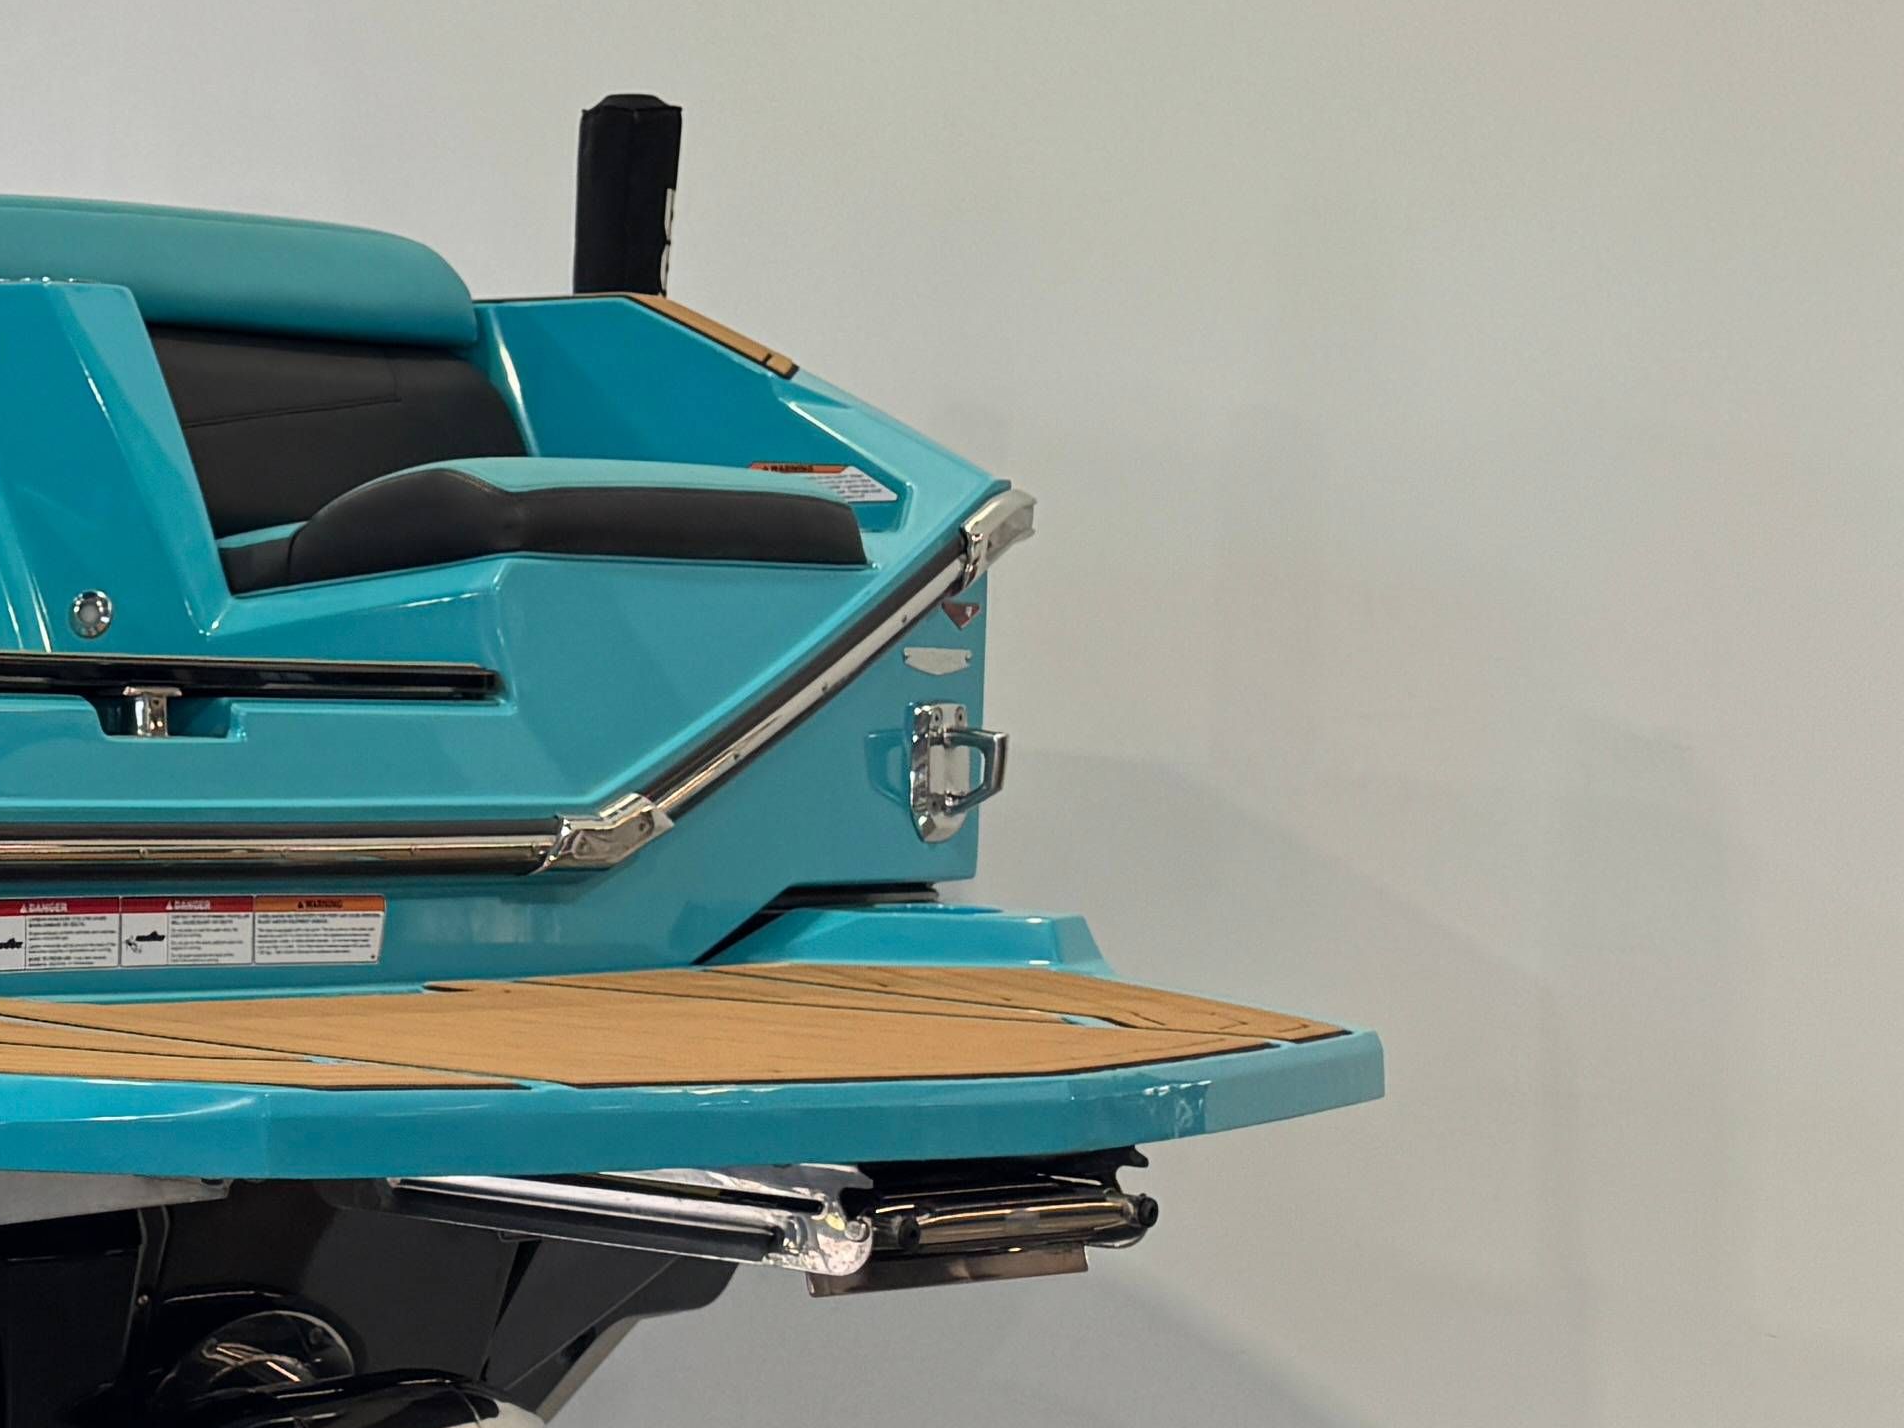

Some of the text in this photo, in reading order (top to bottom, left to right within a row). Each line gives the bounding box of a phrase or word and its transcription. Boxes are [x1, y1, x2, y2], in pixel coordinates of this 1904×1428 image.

[28, 902, 68, 913] DANGER
[173, 900, 211, 910] DANGER
[305, 899, 343, 908] WARNING
